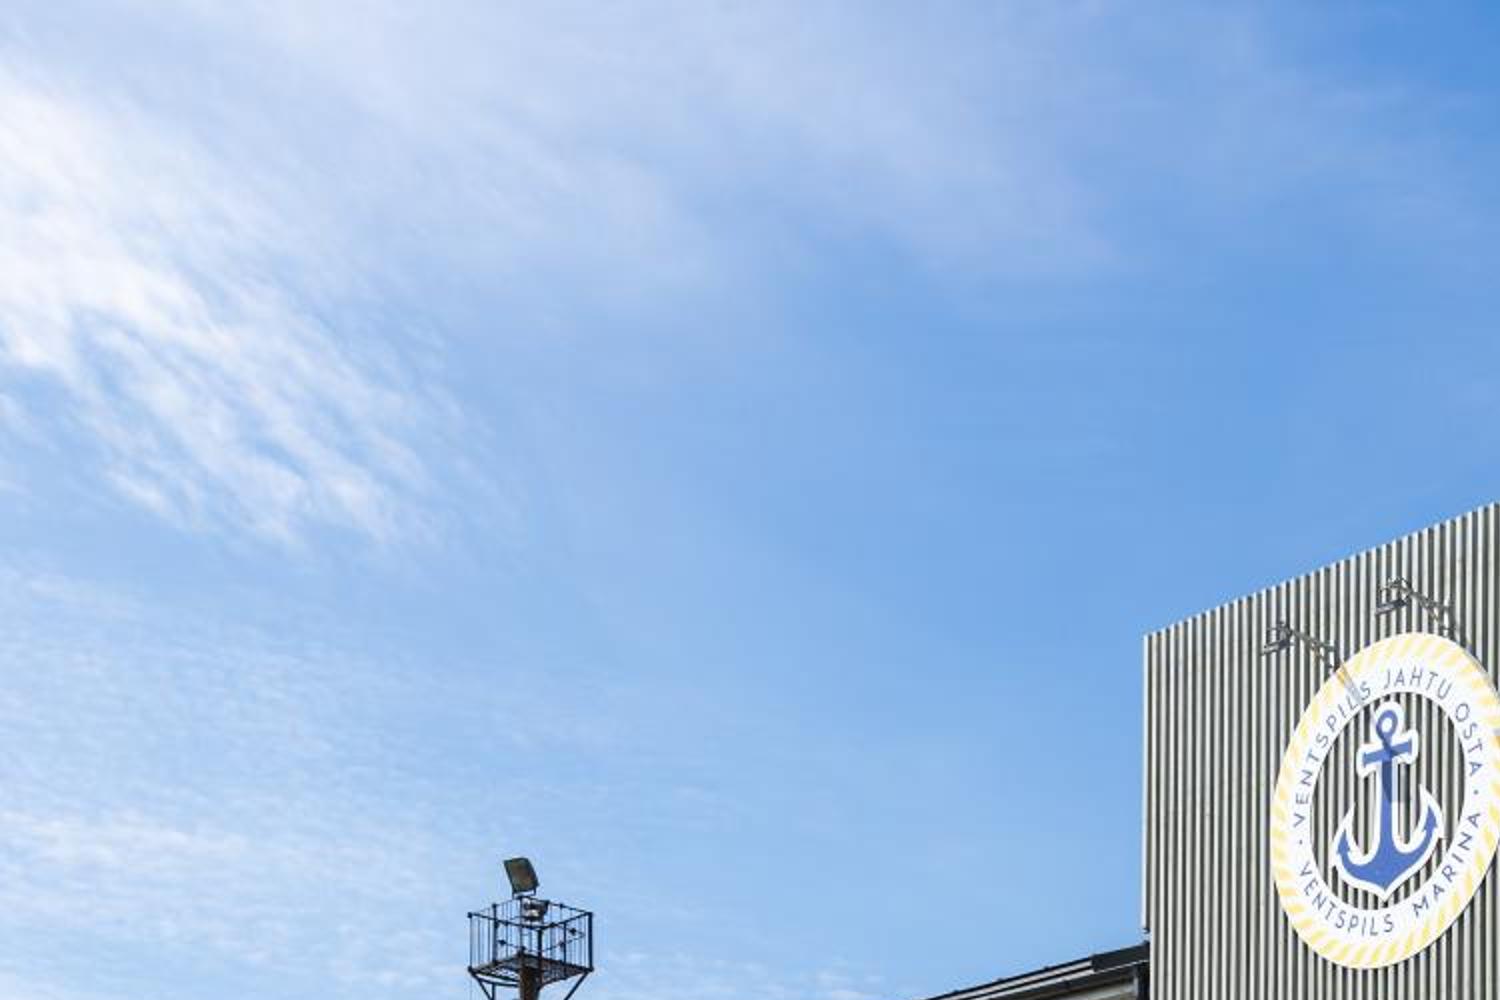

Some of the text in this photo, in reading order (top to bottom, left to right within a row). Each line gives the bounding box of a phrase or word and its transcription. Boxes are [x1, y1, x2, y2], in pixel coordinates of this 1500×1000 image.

[1293, 666, 1484, 828] VENTSPILS JAHTU OSTA
[1300, 812, 1482, 937] VENTSPILS MARINA
